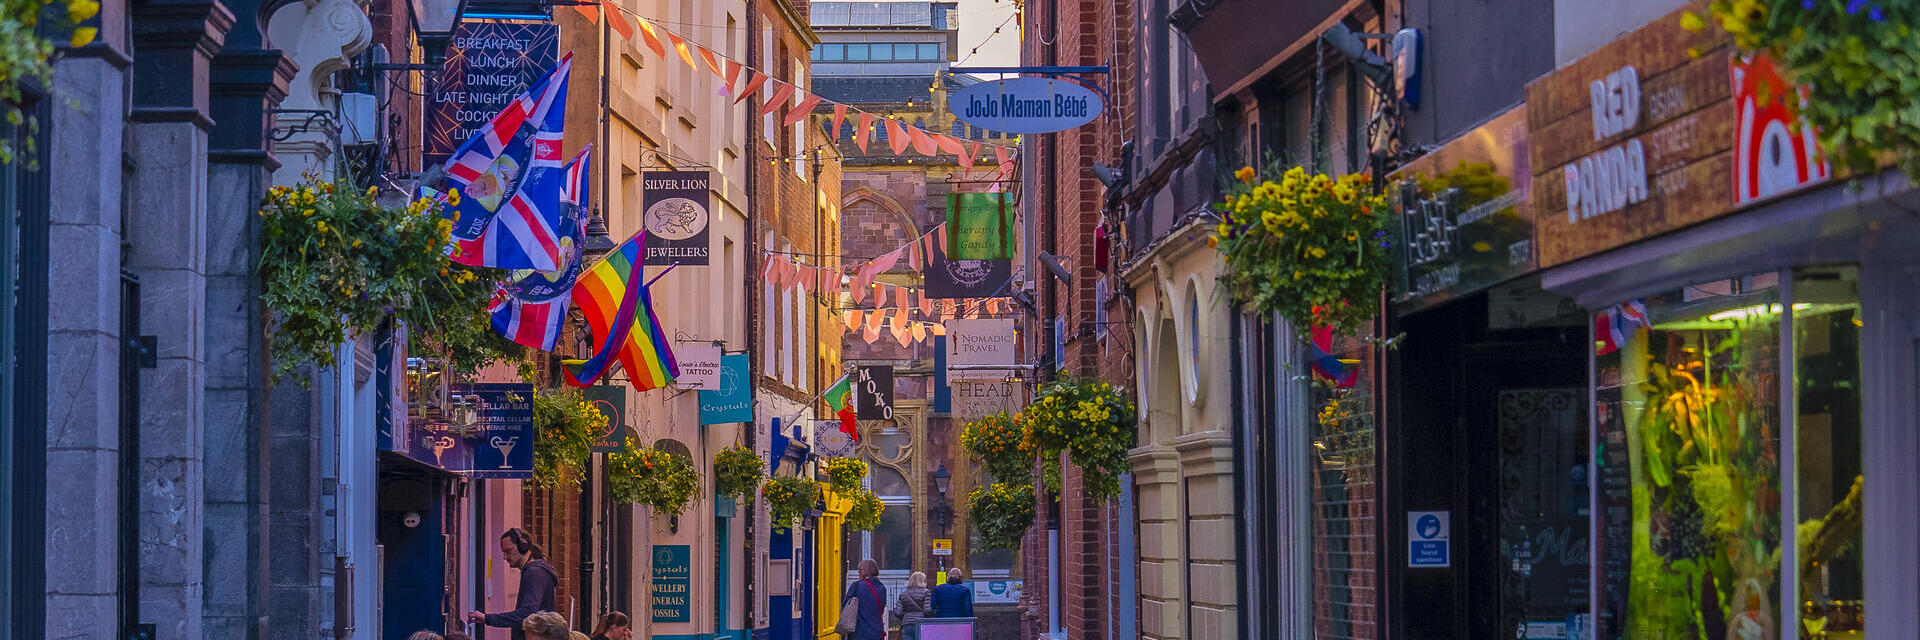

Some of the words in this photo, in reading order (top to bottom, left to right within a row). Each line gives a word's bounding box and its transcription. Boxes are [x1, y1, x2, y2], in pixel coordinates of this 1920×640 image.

[457, 37, 531, 51] BREAKFAST
[470, 55, 515, 69] LUNCH
[467, 74, 517, 87] DINNER
[435, 91, 466, 104] LATE
[469, 92, 509, 105] NIGHT
[1590, 65, 1641, 142] RED
[965, 93, 998, 118] JoJo
[1001, 93, 1051, 118] Maman
[1054, 93, 1088, 118] Bébé
[454, 128, 480, 140] LIV
[644, 179, 679, 190] SILVER
[681, 179, 707, 190] LION
[1564, 138, 1649, 224] PANDA
[645, 247, 708, 260] JEWELLERS
[961, 334, 1011, 343] NOMADIC
[961, 343, 998, 352] TRAVEL
[686, 368, 713, 376] TATTOO
[858, 368, 893, 420] MOKO
[959, 382, 1014, 397] HEAD
[512, 402, 529, 410] BAR
[702, 401, 749, 413] Crystals
[651, 565, 688, 575] ystals
